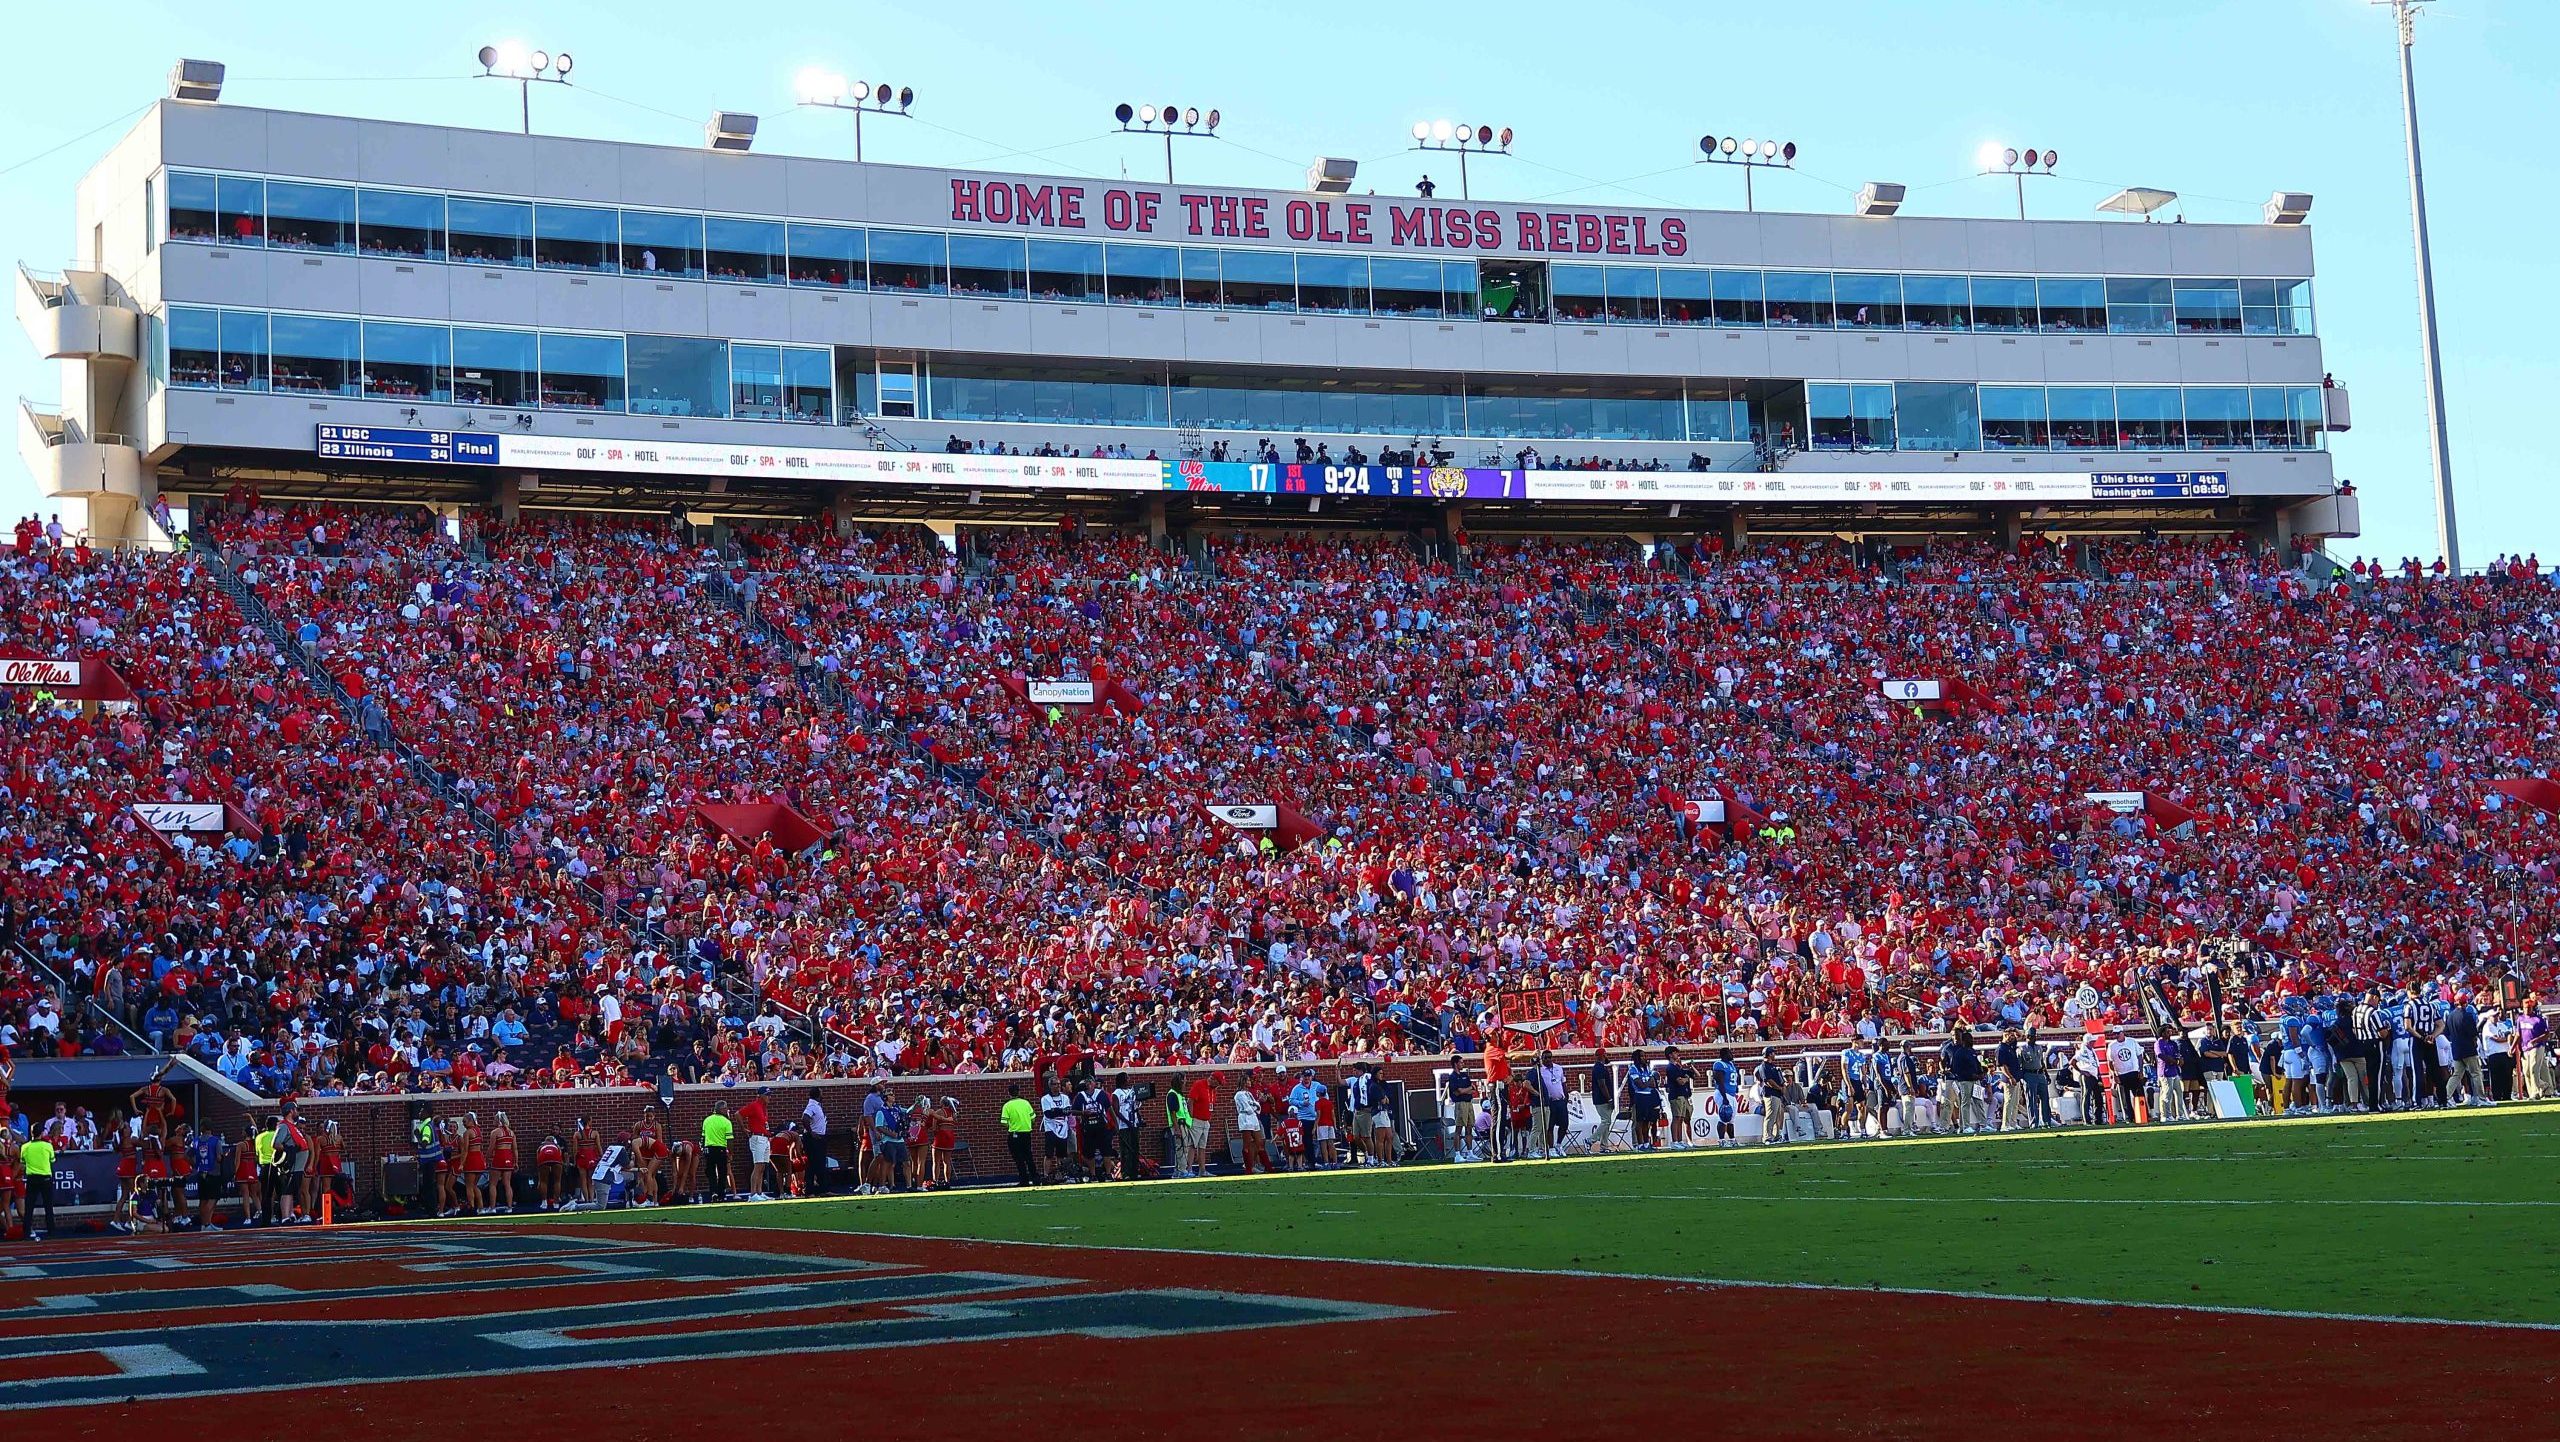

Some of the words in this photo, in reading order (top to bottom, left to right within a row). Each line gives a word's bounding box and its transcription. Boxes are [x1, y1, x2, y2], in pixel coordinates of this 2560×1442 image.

[951, 179, 1085, 228] HOME
[1104, 190, 1161, 233] OF
[1180, 195, 1269, 238] THE
[1286, 201, 1372, 244] OLE
[1390, 206, 1501, 249] MISS
[1517, 212, 1687, 256] REBELS
[322, 428, 337, 439] 21
[342, 428, 370, 439] USC
[430, 434, 448, 444] 32
[322, 443, 340, 454] 23
[344, 444, 394, 457] Illinois
[430, 449, 448, 460] 34
[457, 442, 493, 455] Final
[577, 448, 596, 459] GOLF
[608, 450, 622, 460] SPA
[635, 451, 659, 462] HOTEL
[730, 455, 749, 465] GOLF
[760, 456, 774, 466] SPA
[786, 457, 809, 468] HOTEL
[878, 461, 896, 471] GOLF
[907, 462, 920, 472] SPA
[932, 463, 955, 473] HOTEL
[1179, 460, 1204, 476] Ole
[1024, 466, 1041, 476] GOLF
[1052, 466, 1065, 476] SPA
[1076, 467, 1099, 478] HOTEL
[1249, 464, 1268, 491] 17
[1287, 465, 1301, 477] 1ST
[1386, 467, 1402, 479] QTR
[1186, 476, 1222, 491] Miss
[1295, 479, 1306, 491] 10
[1325, 466, 1370, 494] 9:24
[1500, 470, 1513, 497] 7
[1590, 480, 1606, 490] GOLF
[1616, 480, 1628, 490] SPA
[1638, 480, 1659, 490] HOTEL
[2092, 475, 2098, 483] 1
[2101, 475, 2123, 484] Ohio
[2127, 475, 2155, 483] State
[2176, 474, 2187, 483] 17
[2199, 475, 2218, 484] 4th
[1391, 481, 1399, 494] 3
[1719, 481, 1734, 491] GOLF
[1743, 481, 1756, 490] SPA
[1765, 482, 1786, 491] HOTEL
[1845, 481, 1860, 491] GOLF
[1869, 481, 1881, 491] SPA
[1891, 482, 1911, 491] HOTEL
[1970, 482, 1985, 491] GOLF
[1994, 481, 2006, 491] SPA
[2015, 482, 2035, 491] HOTEL
[2093, 488, 2154, 498] Washington
[2182, 487, 2188, 496] 6
[2193, 485, 2225, 494] 08:50
[6, 662, 31, 682] Ole
[31, 662, 72, 683] Miss
[1033, 687, 1089, 697] CanopyNation
[1232, 809, 1251, 818] Ford
[2506, 981, 2517, 999] 1
[2081, 990, 2096, 1004] SEC
[2420, 1005, 2430, 1021] C
[2118, 1049, 2131, 1060] SEC
[604, 1066, 615, 1075] 10
[1694, 1120, 1710, 1137] SEC
[1288, 1131, 1300, 1147] 13
